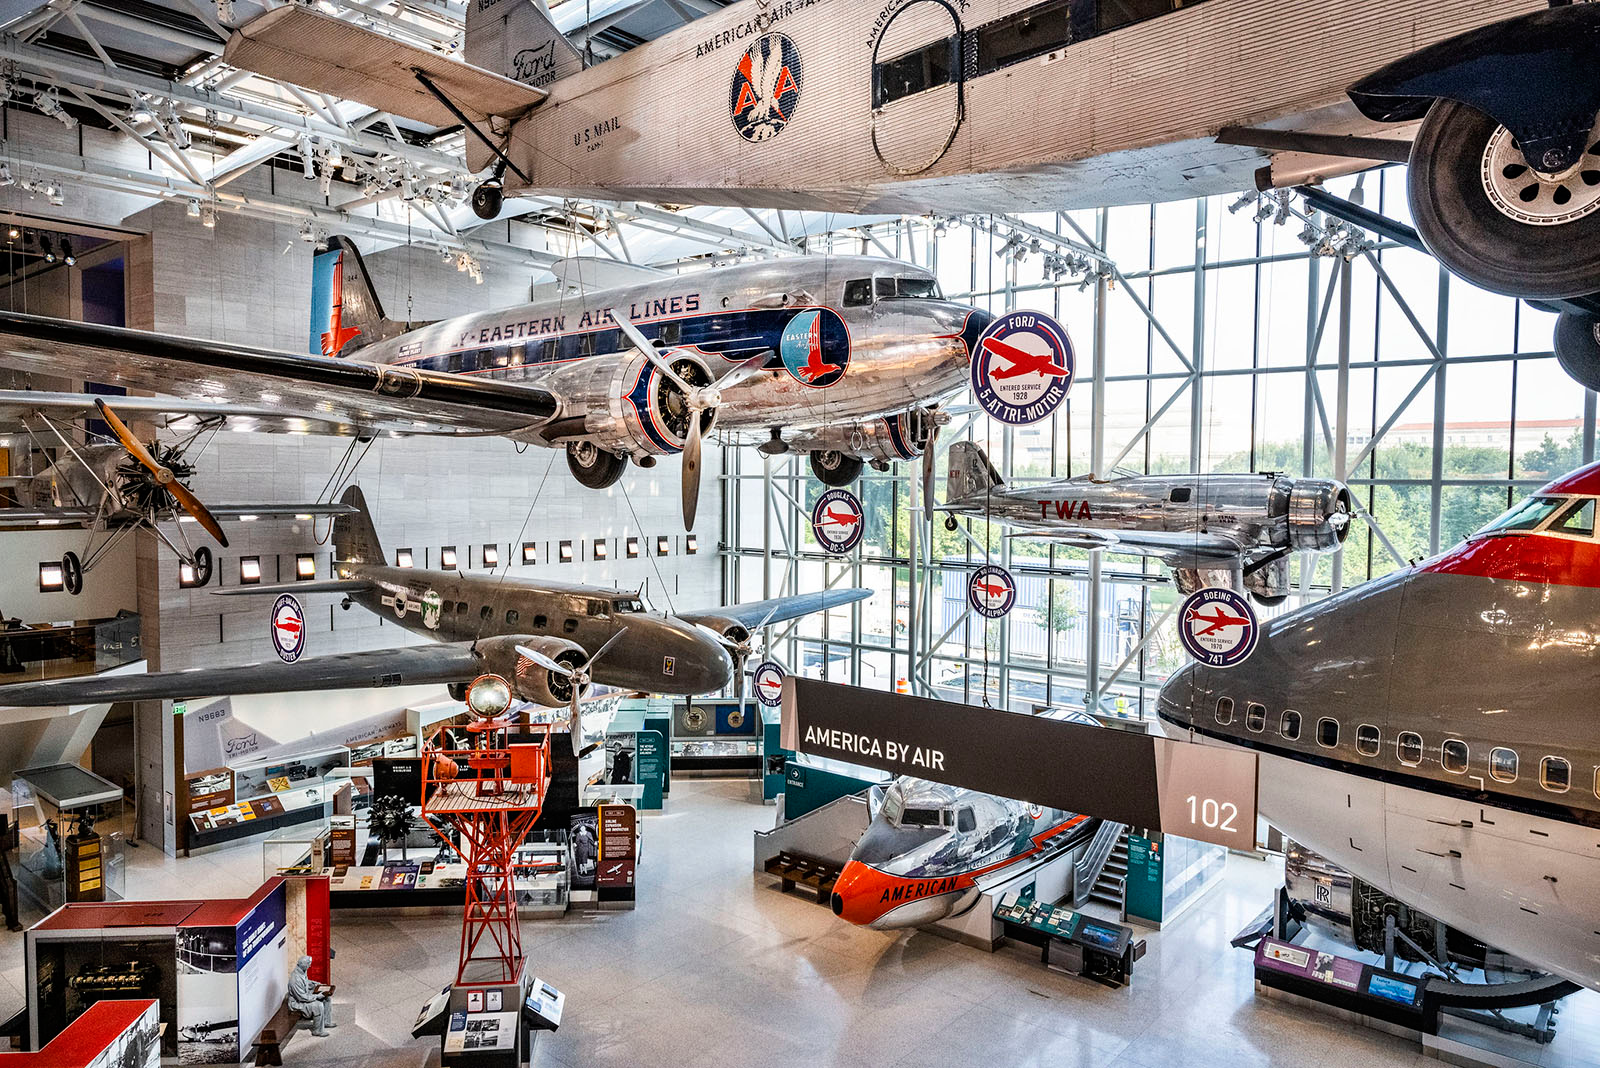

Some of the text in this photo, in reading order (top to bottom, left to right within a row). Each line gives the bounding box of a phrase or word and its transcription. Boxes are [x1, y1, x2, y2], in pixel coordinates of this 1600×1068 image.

[696, 13, 763, 58] AMERICAN
[528, 70, 556, 88] MOTOR
[594, 116, 621, 138] MAIL
[578, 307, 615, 328] AIR
[629, 293, 700, 320] LINES
[1008, 315, 1035, 330] FORD
[786, 332, 819, 342] EASTERN
[1013, 392, 1028, 401] 1928
[1021, 383, 1042, 391] SERVICE
[979, 385, 1064, 422] 5-AT TRI-MOTOR
[826, 491, 850, 501] DOUGLAS
[1038, 500, 1092, 520] TWA
[829, 543, 845, 552] DC-3
[1203, 591, 1232, 602] BOEING
[1208, 653, 1224, 665] 747
[224, 733, 258, 753] Ford
[804, 725, 945, 771] AMERICA BY AIR
[1186, 795, 1238, 833] 102
[879, 876, 959, 904] AMERICAN
